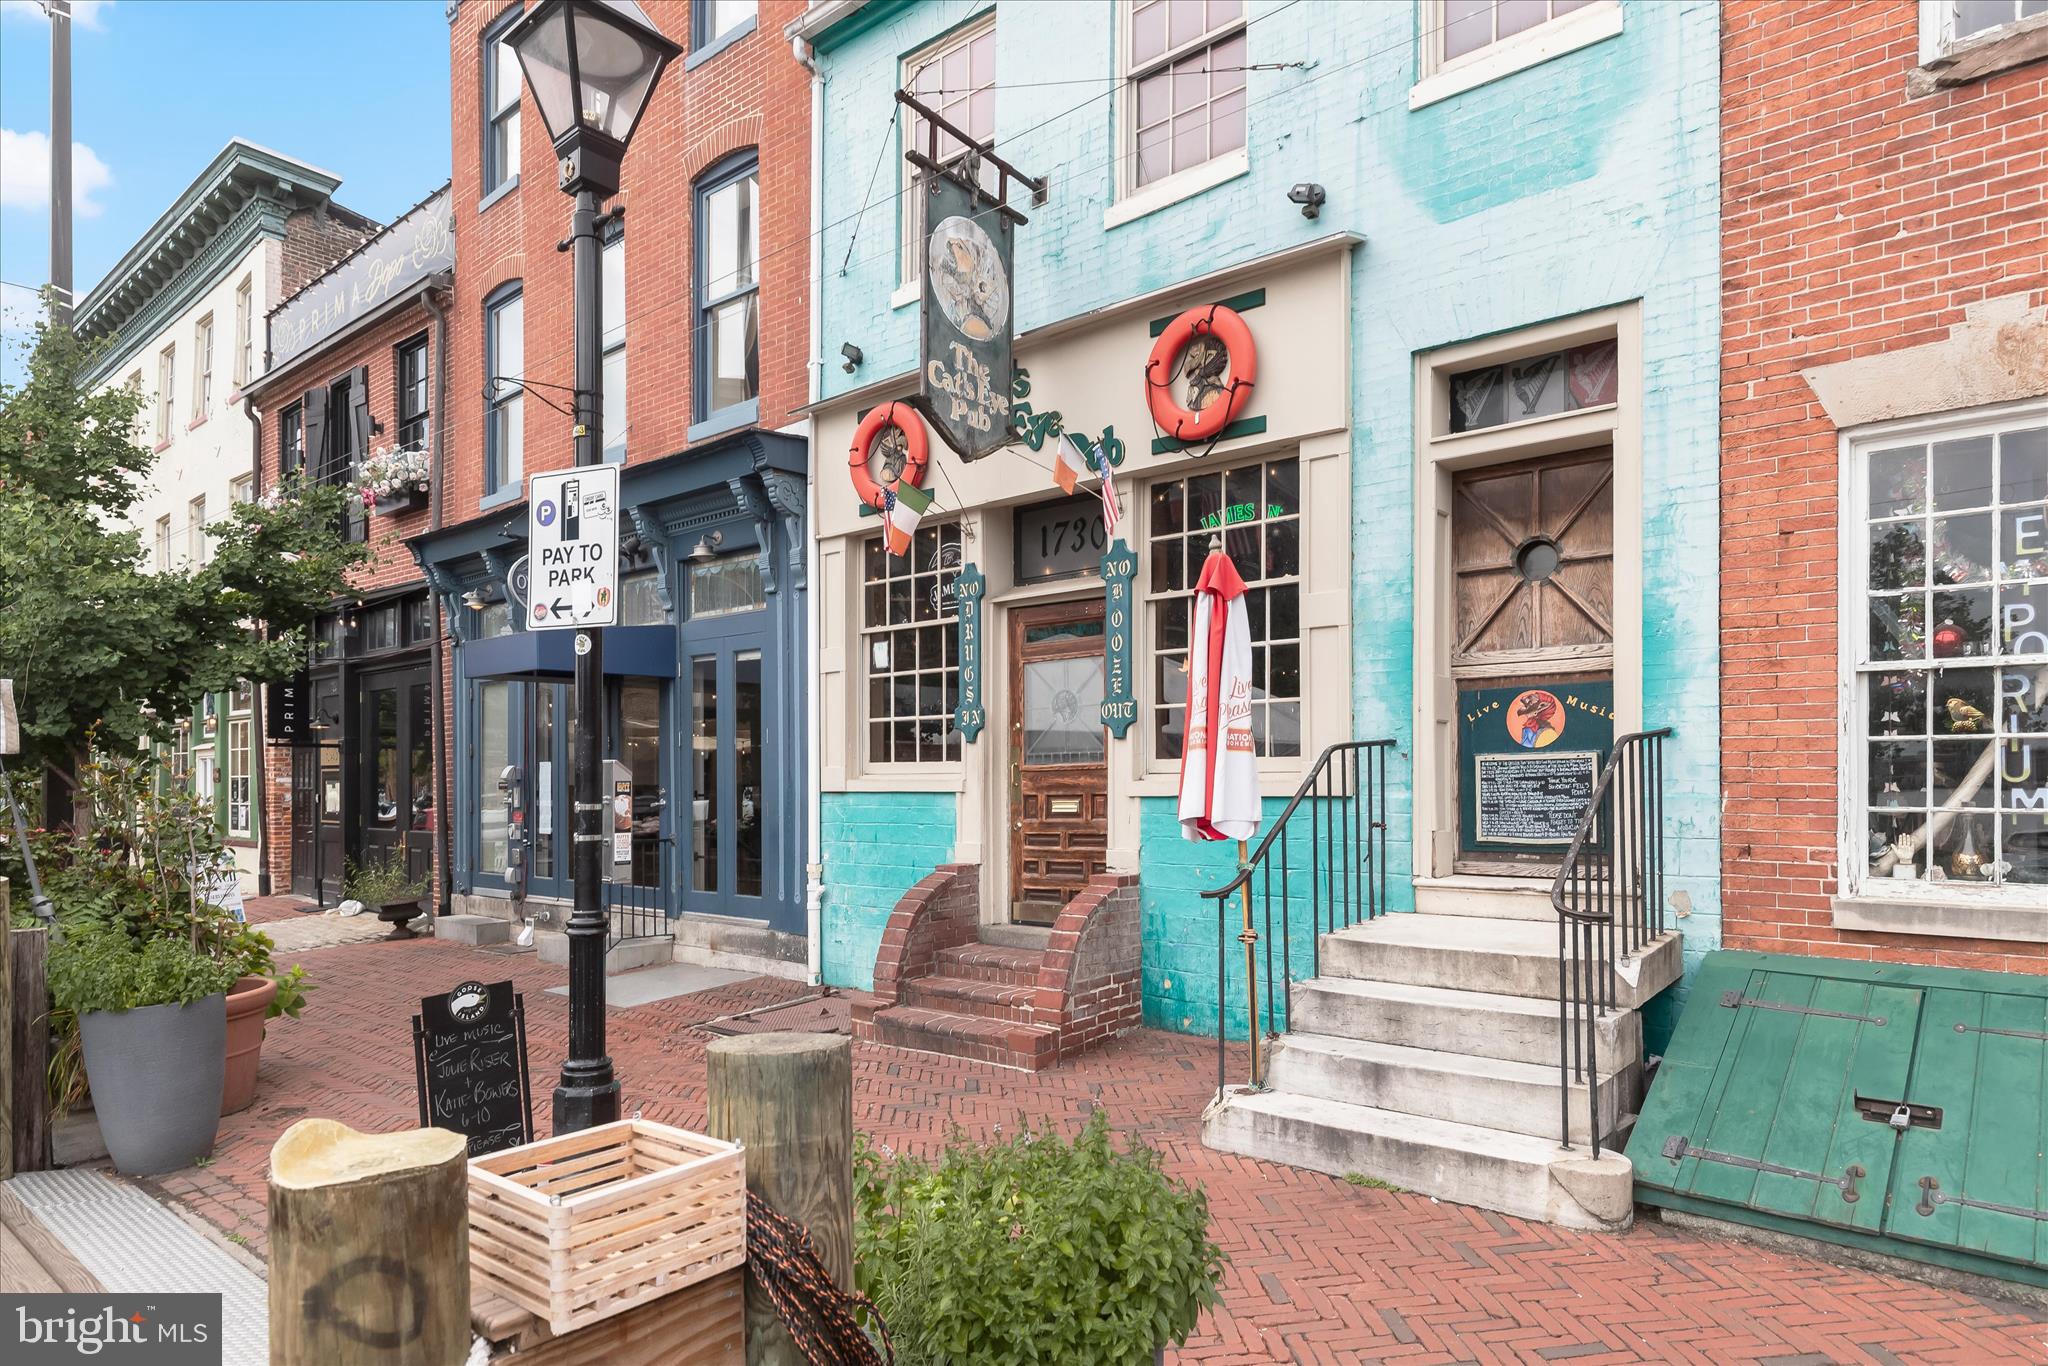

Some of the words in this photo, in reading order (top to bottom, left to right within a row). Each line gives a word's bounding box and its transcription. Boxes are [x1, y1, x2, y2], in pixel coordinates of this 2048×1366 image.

[299, 281, 359, 339] PRIMA
[365, 254, 404, 303] Dopo
[949, 340, 990, 382] The
[927, 359, 976, 400] Cat's
[976, 380, 1009, 416] Eye
[949, 394, 992, 433] Pub
[1012, 401, 1064, 453] Eye
[1040, 515, 1106, 559] 1730
[542, 545, 575, 566] PAY
[579, 543, 603, 563] TO
[549, 566, 595, 588] PARK
[1105, 559, 1131, 578] NO
[959, 582, 979, 599] NO
[963, 600, 976, 705] DRUGS
[1110, 583, 1124, 697] BOOZE
[1229, 675, 1252, 700] Live
[284, 687, 294, 733] PRIM
[961, 707, 982, 727] IN
[1101, 701, 1134, 720] OUT
[1466, 700, 1500, 723] Live
[1566, 694, 1615, 721] Music
[456, 985, 482, 997] GOOSE
[457, 1006, 485, 1020] ISLAND
[435, 1033, 458, 1048] LIVE
[464, 1023, 505, 1041] MUSIC
[436, 1058, 468, 1079] JULIE
[470, 1047, 512, 1072] RISER
[461, 1106, 491, 1127] 6-10
[467, 1132, 502, 1154] PLEASE
